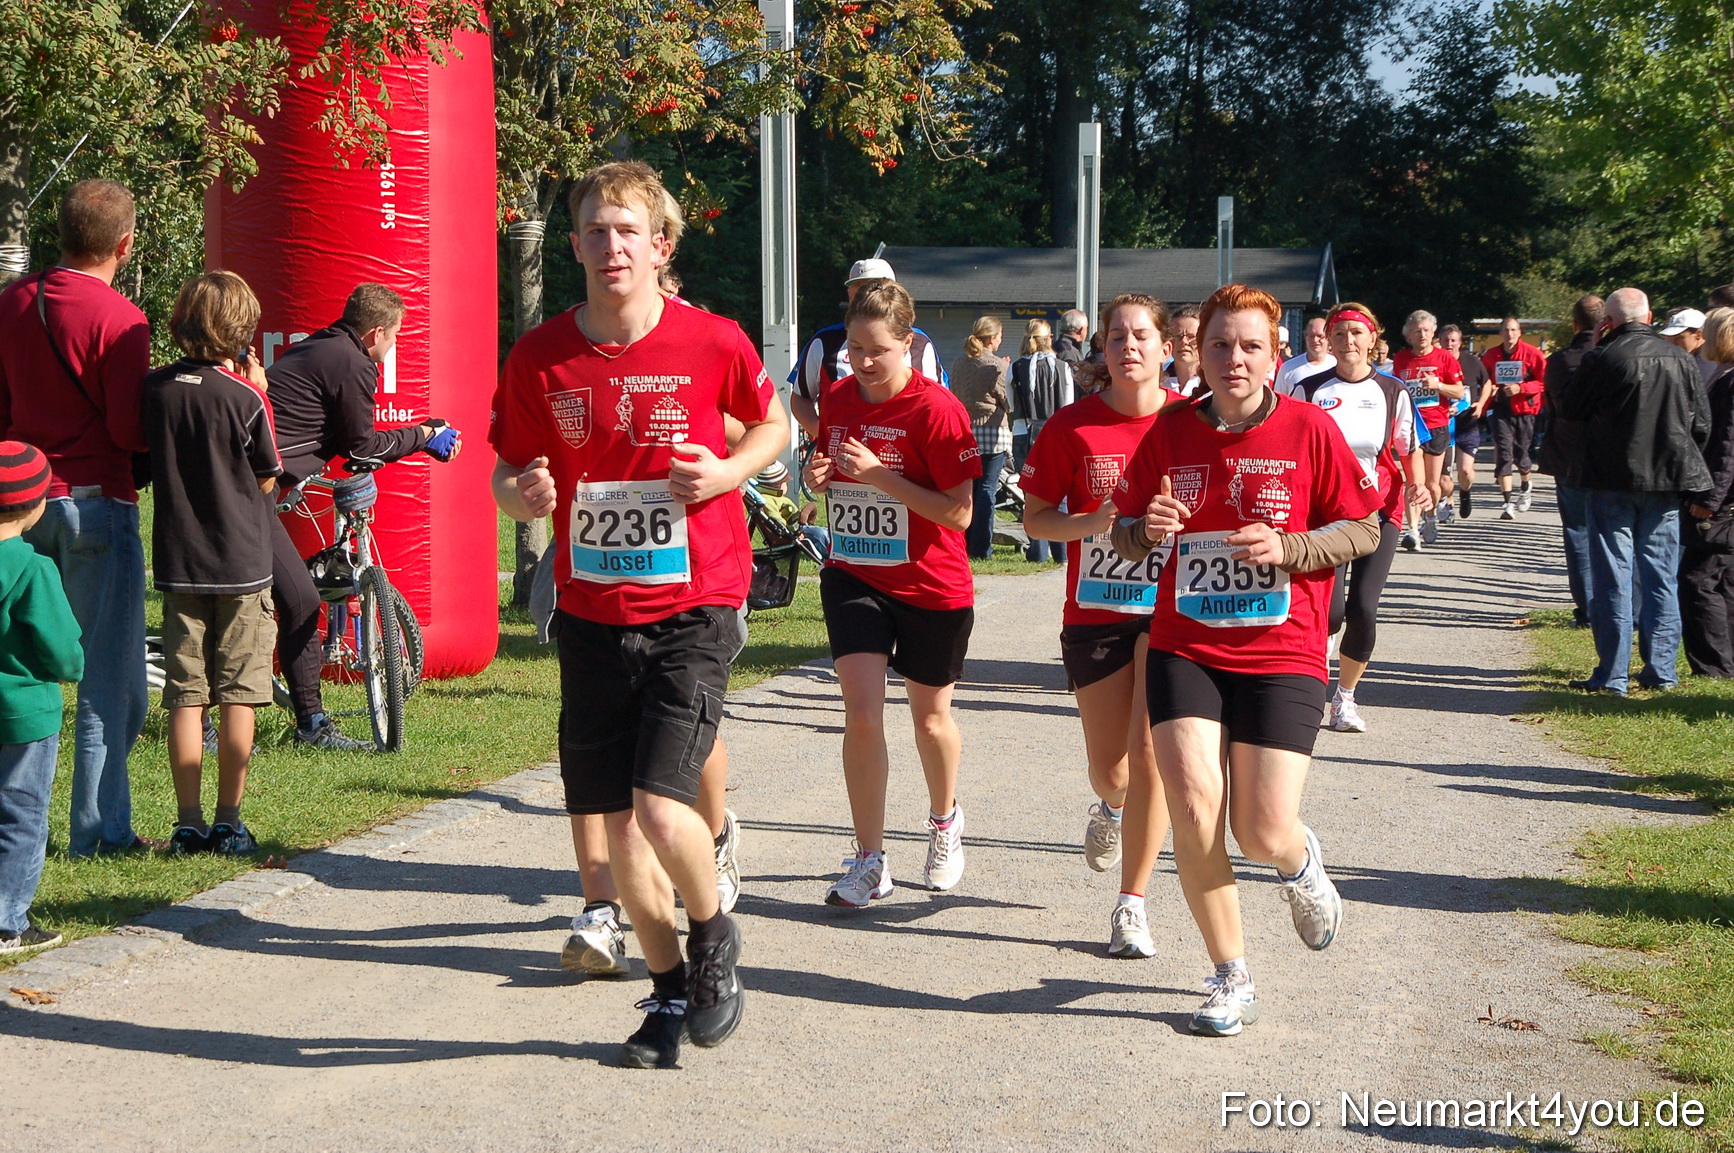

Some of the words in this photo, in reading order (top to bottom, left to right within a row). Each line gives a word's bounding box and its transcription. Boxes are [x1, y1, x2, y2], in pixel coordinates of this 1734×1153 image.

[381, 163, 395, 197] 1929
[381, 203, 395, 230] Seit
[1498, 367, 1519, 376] 3257
[609, 377, 623, 386] 11.
[624, 375, 692, 385] NEUMARKTER
[622, 384, 678, 393] STADTLAUF
[551, 397, 584, 409] IMMER
[552, 407, 586, 418] WIEDER
[557, 417, 584, 430] NEU
[562, 431, 585, 439] MARKT
[864, 431, 897, 441] STADTLAUF
[868, 426, 907, 437] NEUMARKTER
[1226, 458, 1237, 466] 11.
[1238, 458, 1297, 469] NEUMARKTER
[1090, 469, 1120, 477] WIEDER
[1236, 466, 1285, 475] STADTLAUF
[1091, 477, 1118, 488] NEU
[1173, 473, 1202, 482] IMMER
[1092, 487, 1115, 495] MARK
[1172, 481, 1202, 490] WIEDER
[834, 489, 868, 498] PFLEIDERER
[1174, 489, 1199, 500] NEU
[833, 503, 898, 537] 2303
[577, 508, 672, 547] 2236
[840, 536, 890, 555] Kathrin
[599, 551, 653, 571] Josef
[1089, 547, 1164, 582] 2226
[1188, 557, 1276, 592] 2359
[1103, 583, 1143, 602] Julia
[1200, 596, 1267, 615] Andera
